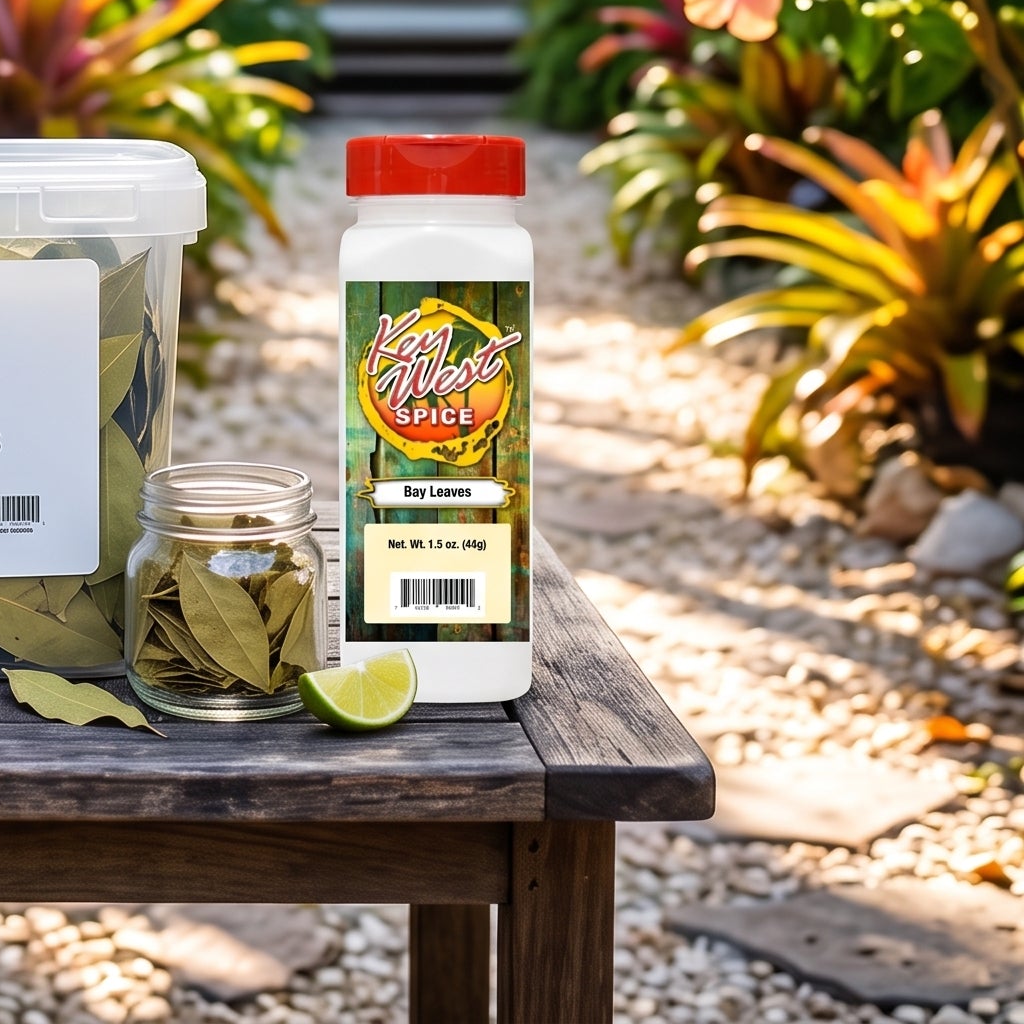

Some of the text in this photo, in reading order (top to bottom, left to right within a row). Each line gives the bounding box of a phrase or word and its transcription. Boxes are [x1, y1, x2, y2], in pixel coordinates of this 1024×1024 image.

[366, 308, 454, 376] Key
[376, 331, 522, 410] West
[395, 407, 474, 425] SPICE
[404, 485, 472, 500] Bay Leaves
[388, 539, 407, 549] Net.
[410, 539, 426, 549] Wt.
[428, 539, 443, 549] 1.5
[445, 541, 460, 549] oz.
